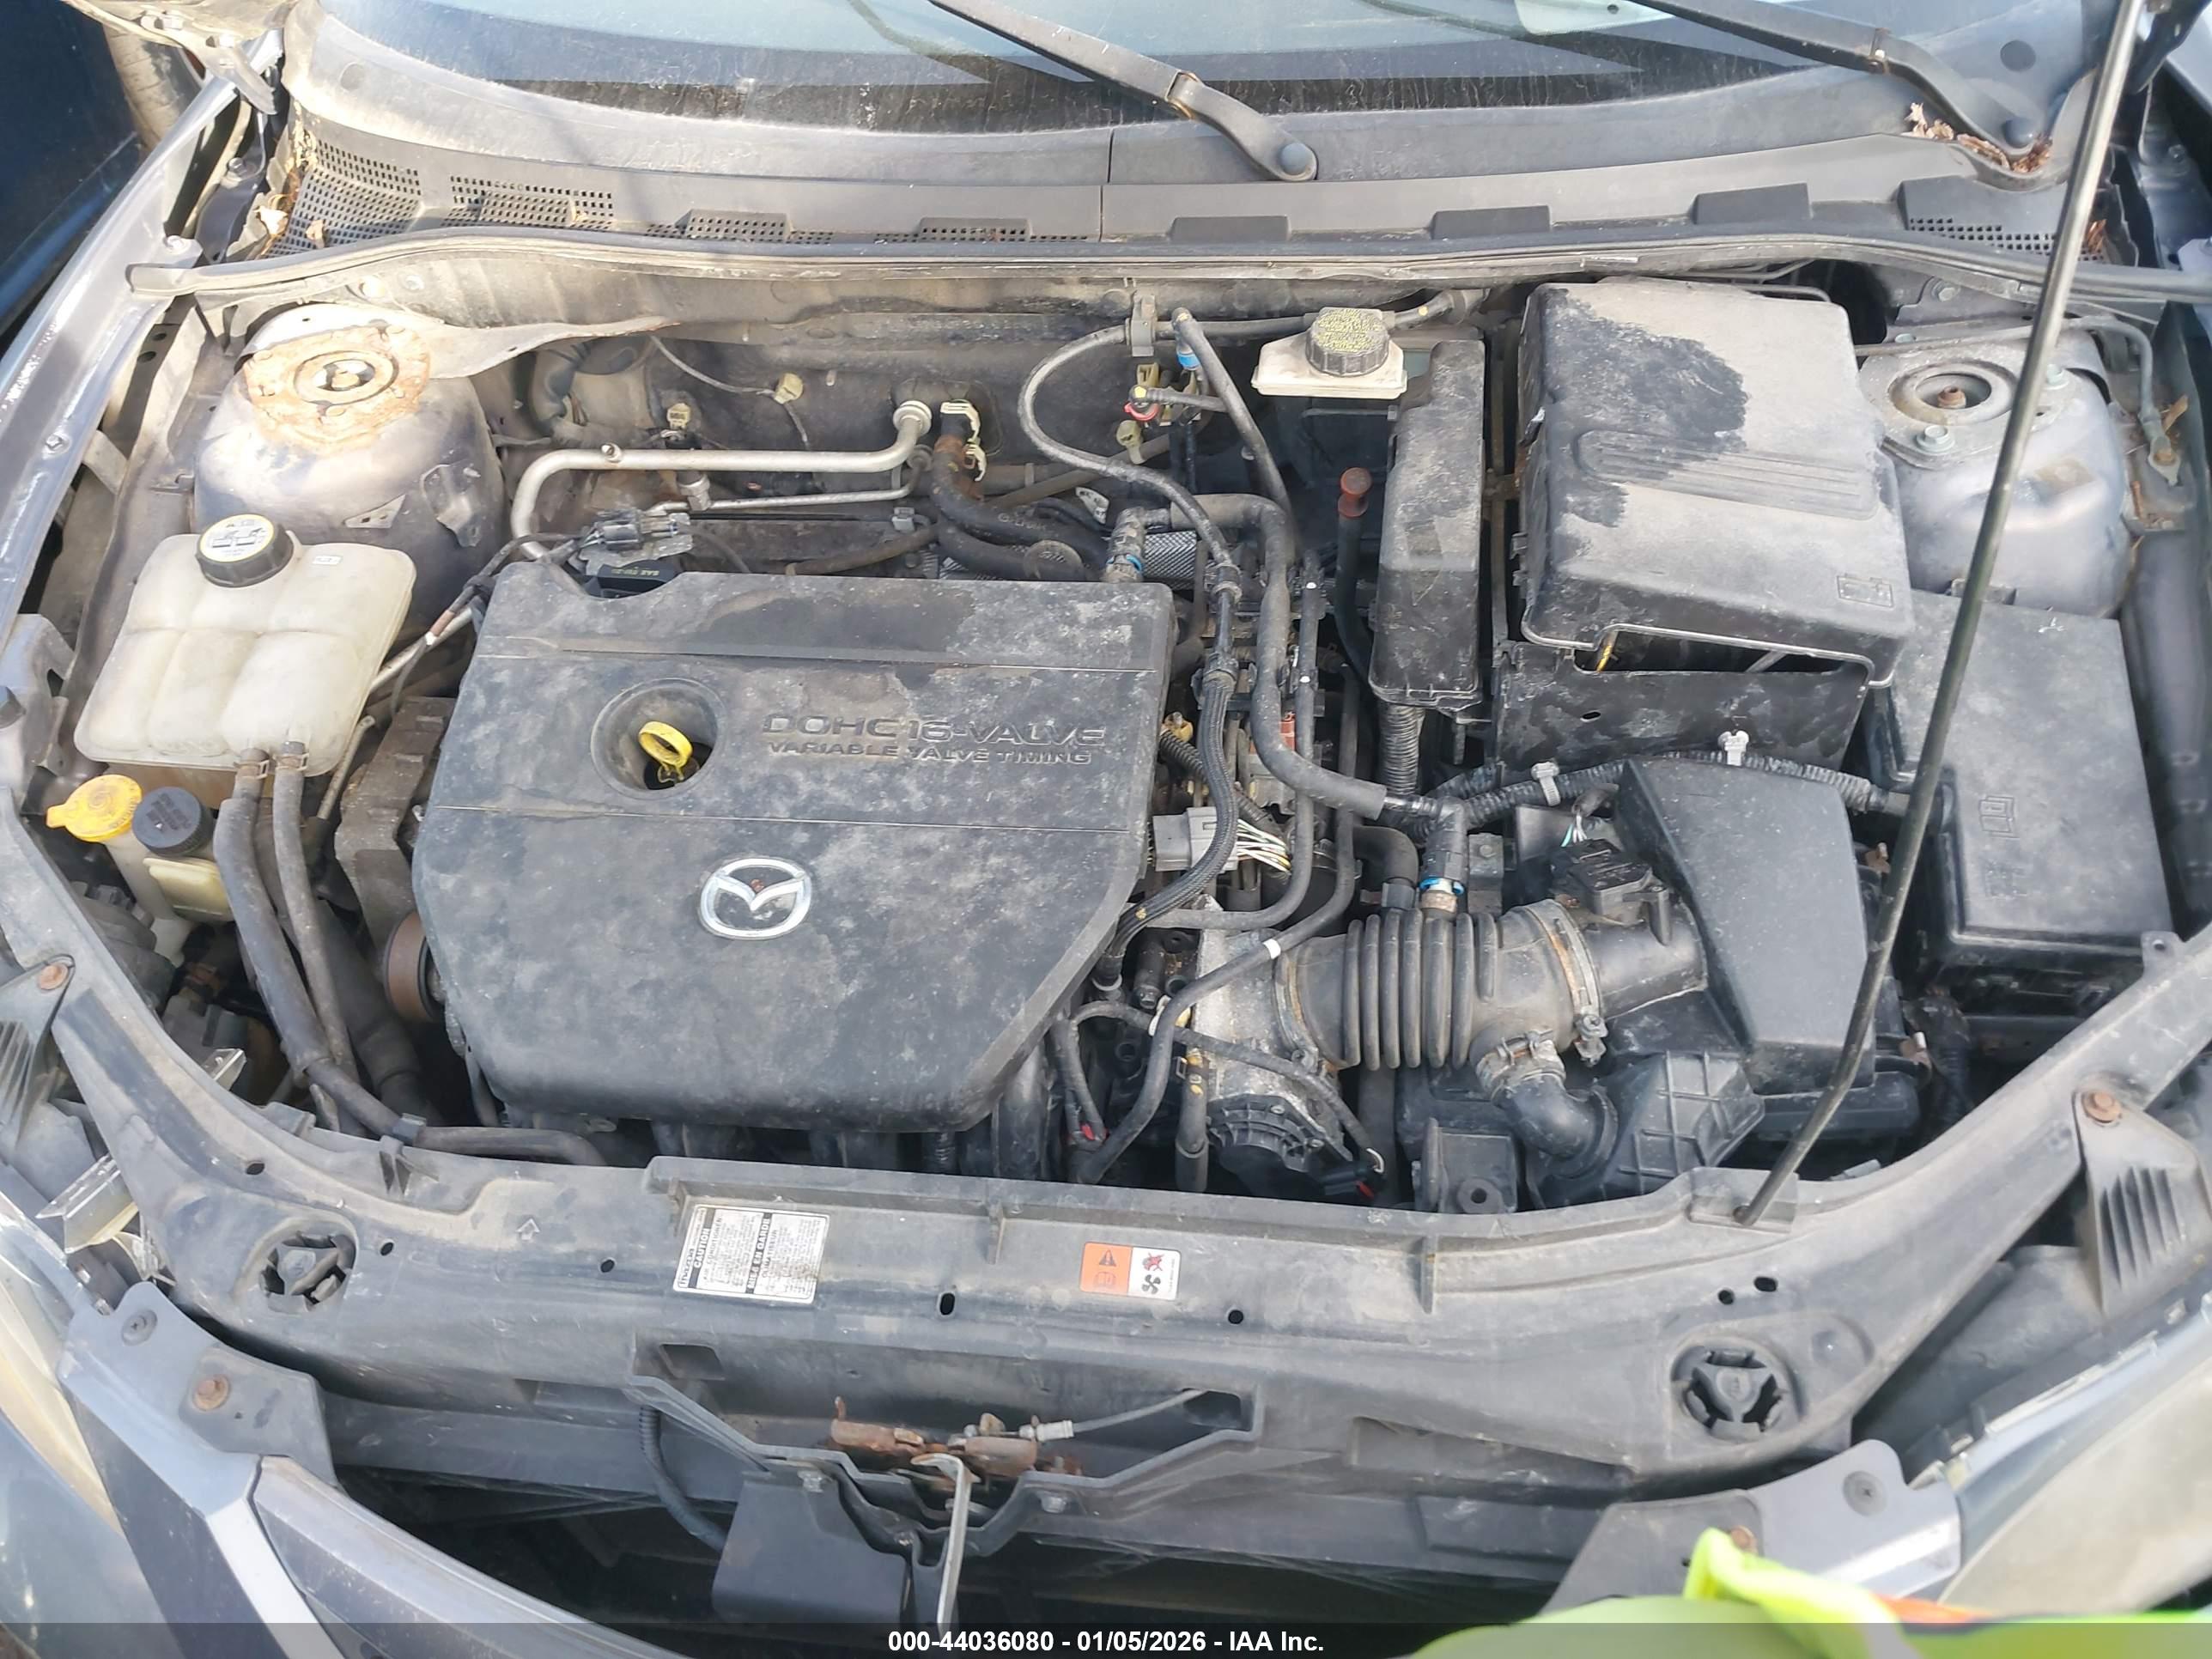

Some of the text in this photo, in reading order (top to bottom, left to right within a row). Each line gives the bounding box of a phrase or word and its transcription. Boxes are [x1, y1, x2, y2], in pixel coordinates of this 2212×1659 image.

[763, 713, 1106, 746] DOHC 16-VALVE
[768, 741, 1092, 765] VARIABLE VALVE TIMING
[693, 1228, 711, 1268] CAUTION
